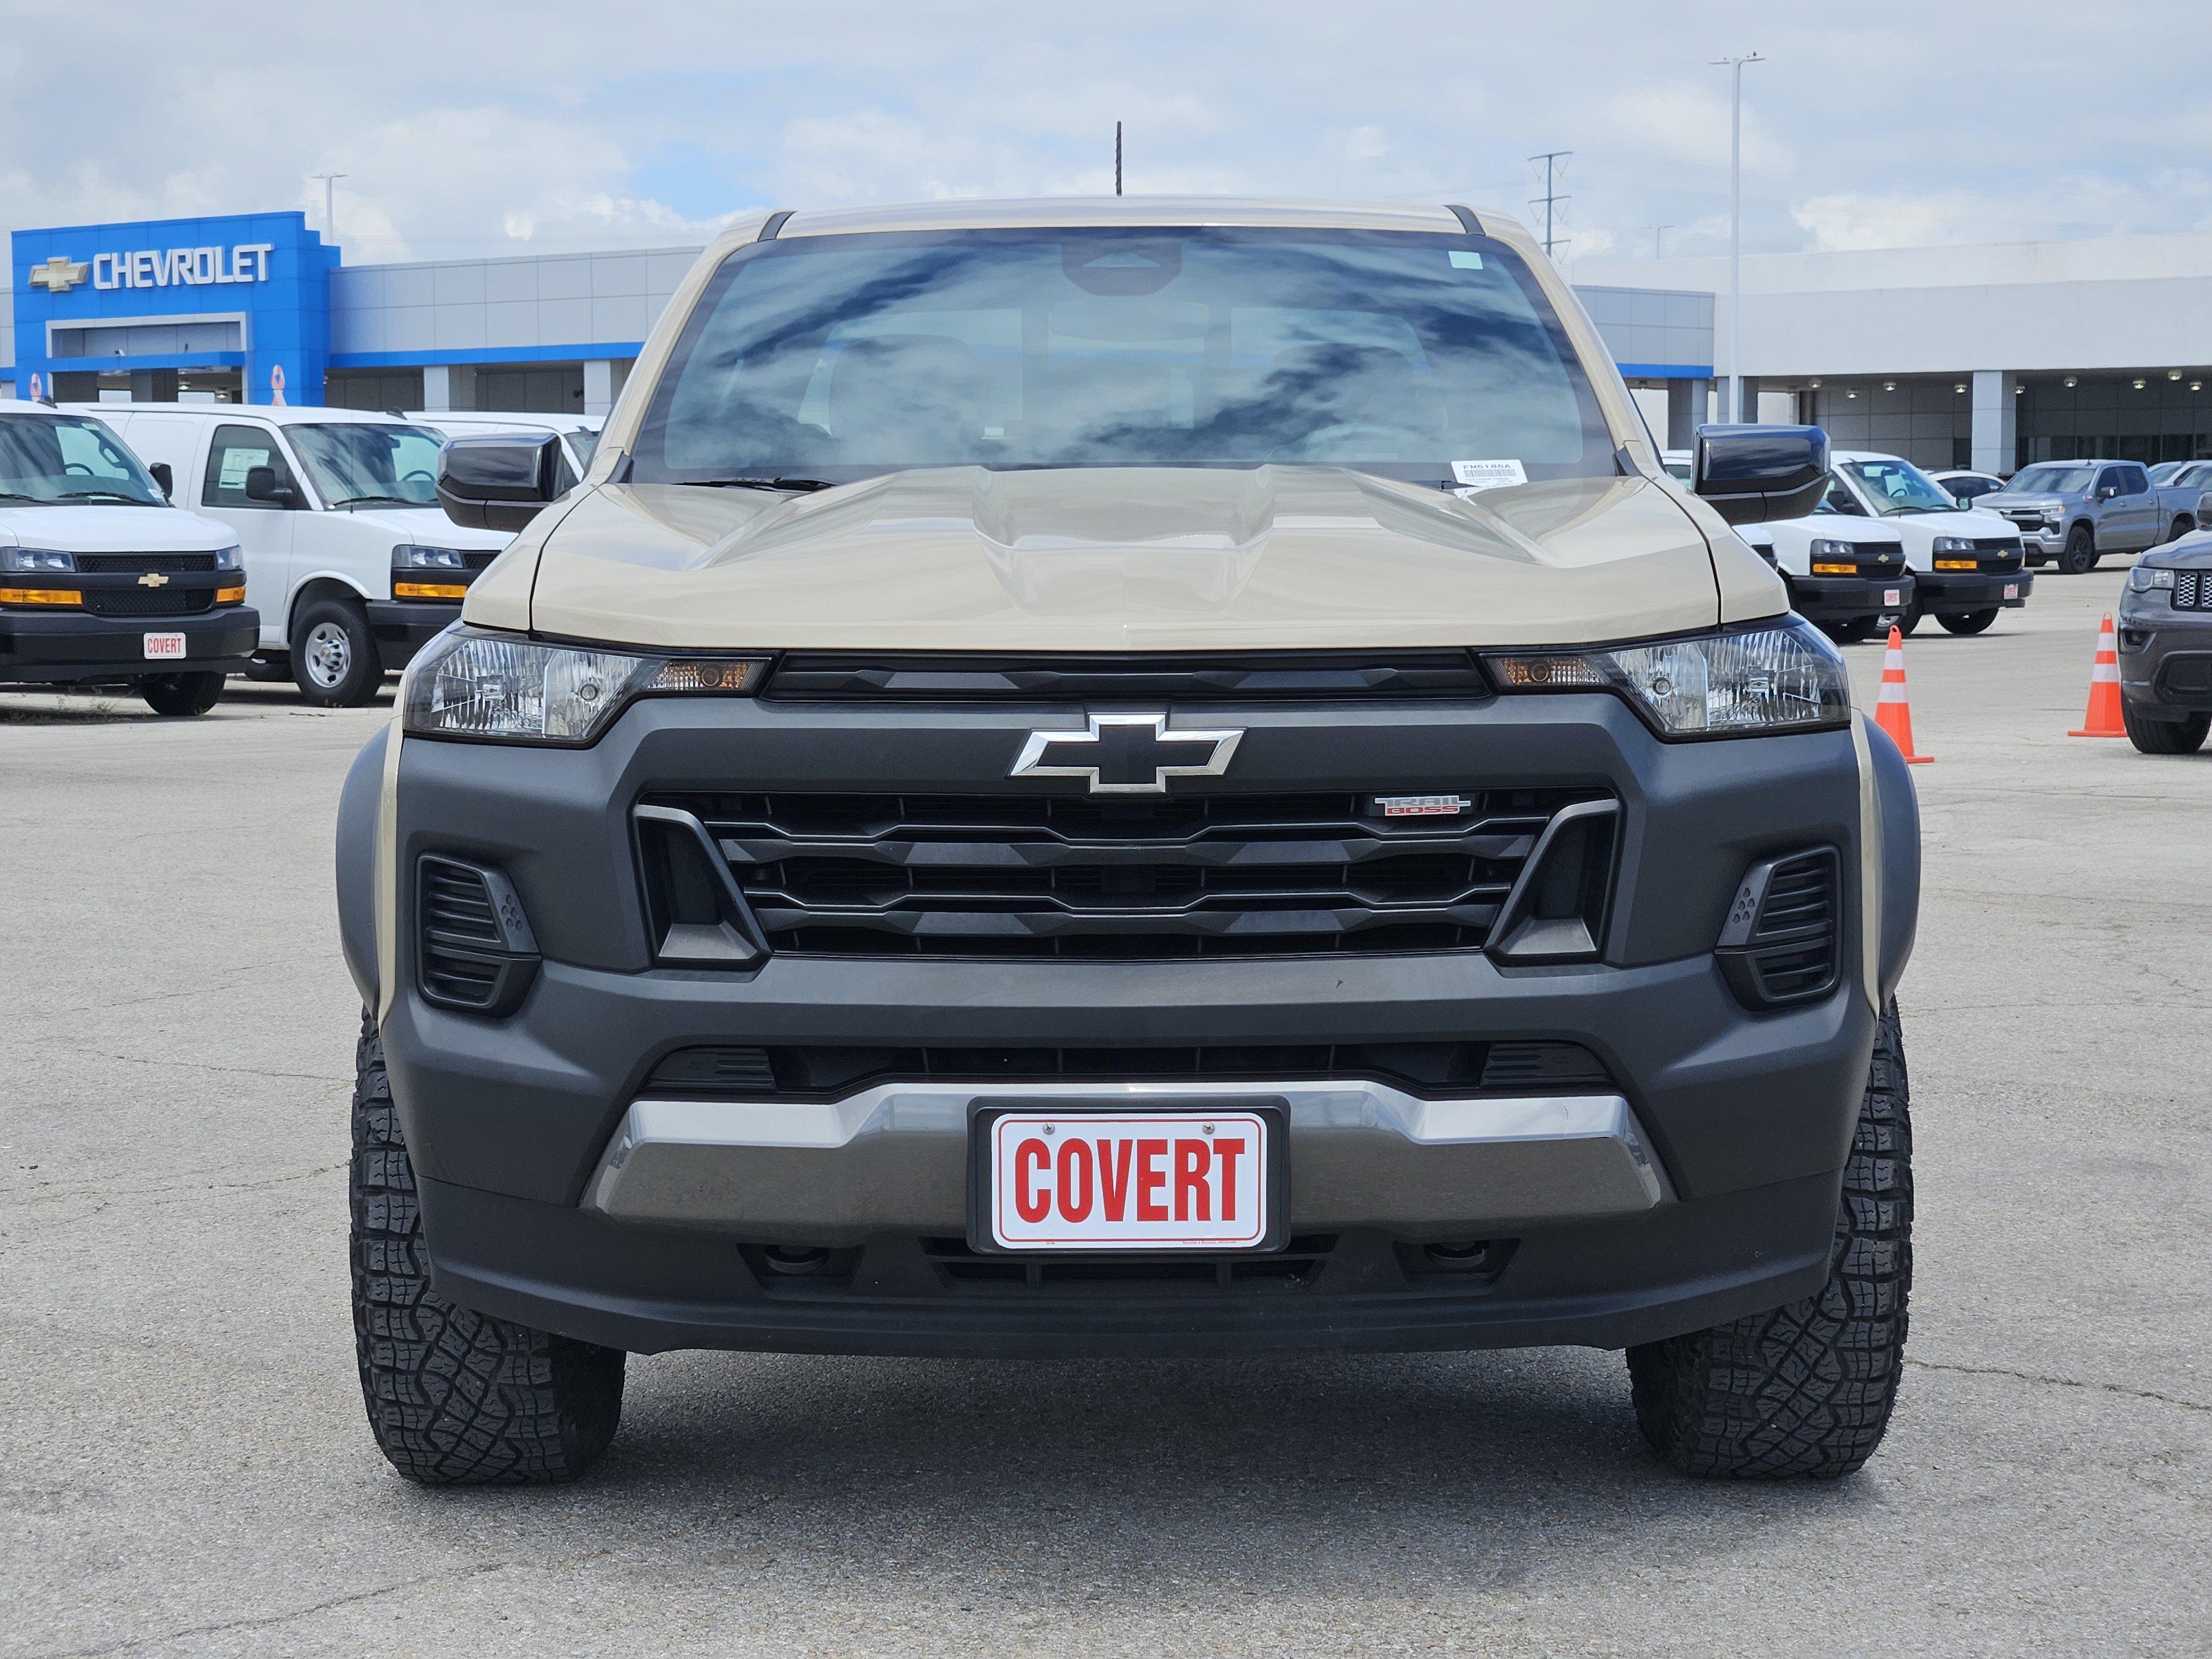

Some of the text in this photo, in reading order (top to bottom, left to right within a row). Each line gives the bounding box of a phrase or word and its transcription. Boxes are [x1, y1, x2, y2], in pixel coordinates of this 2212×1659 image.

[93, 243, 274, 290] CHEVROLET
[148, 638, 181, 653] COVERT
[1375, 795, 1471, 807] TRAIL
[1387, 806, 1458, 814] BOSS
[1015, 1138, 1245, 1224] COVERT
